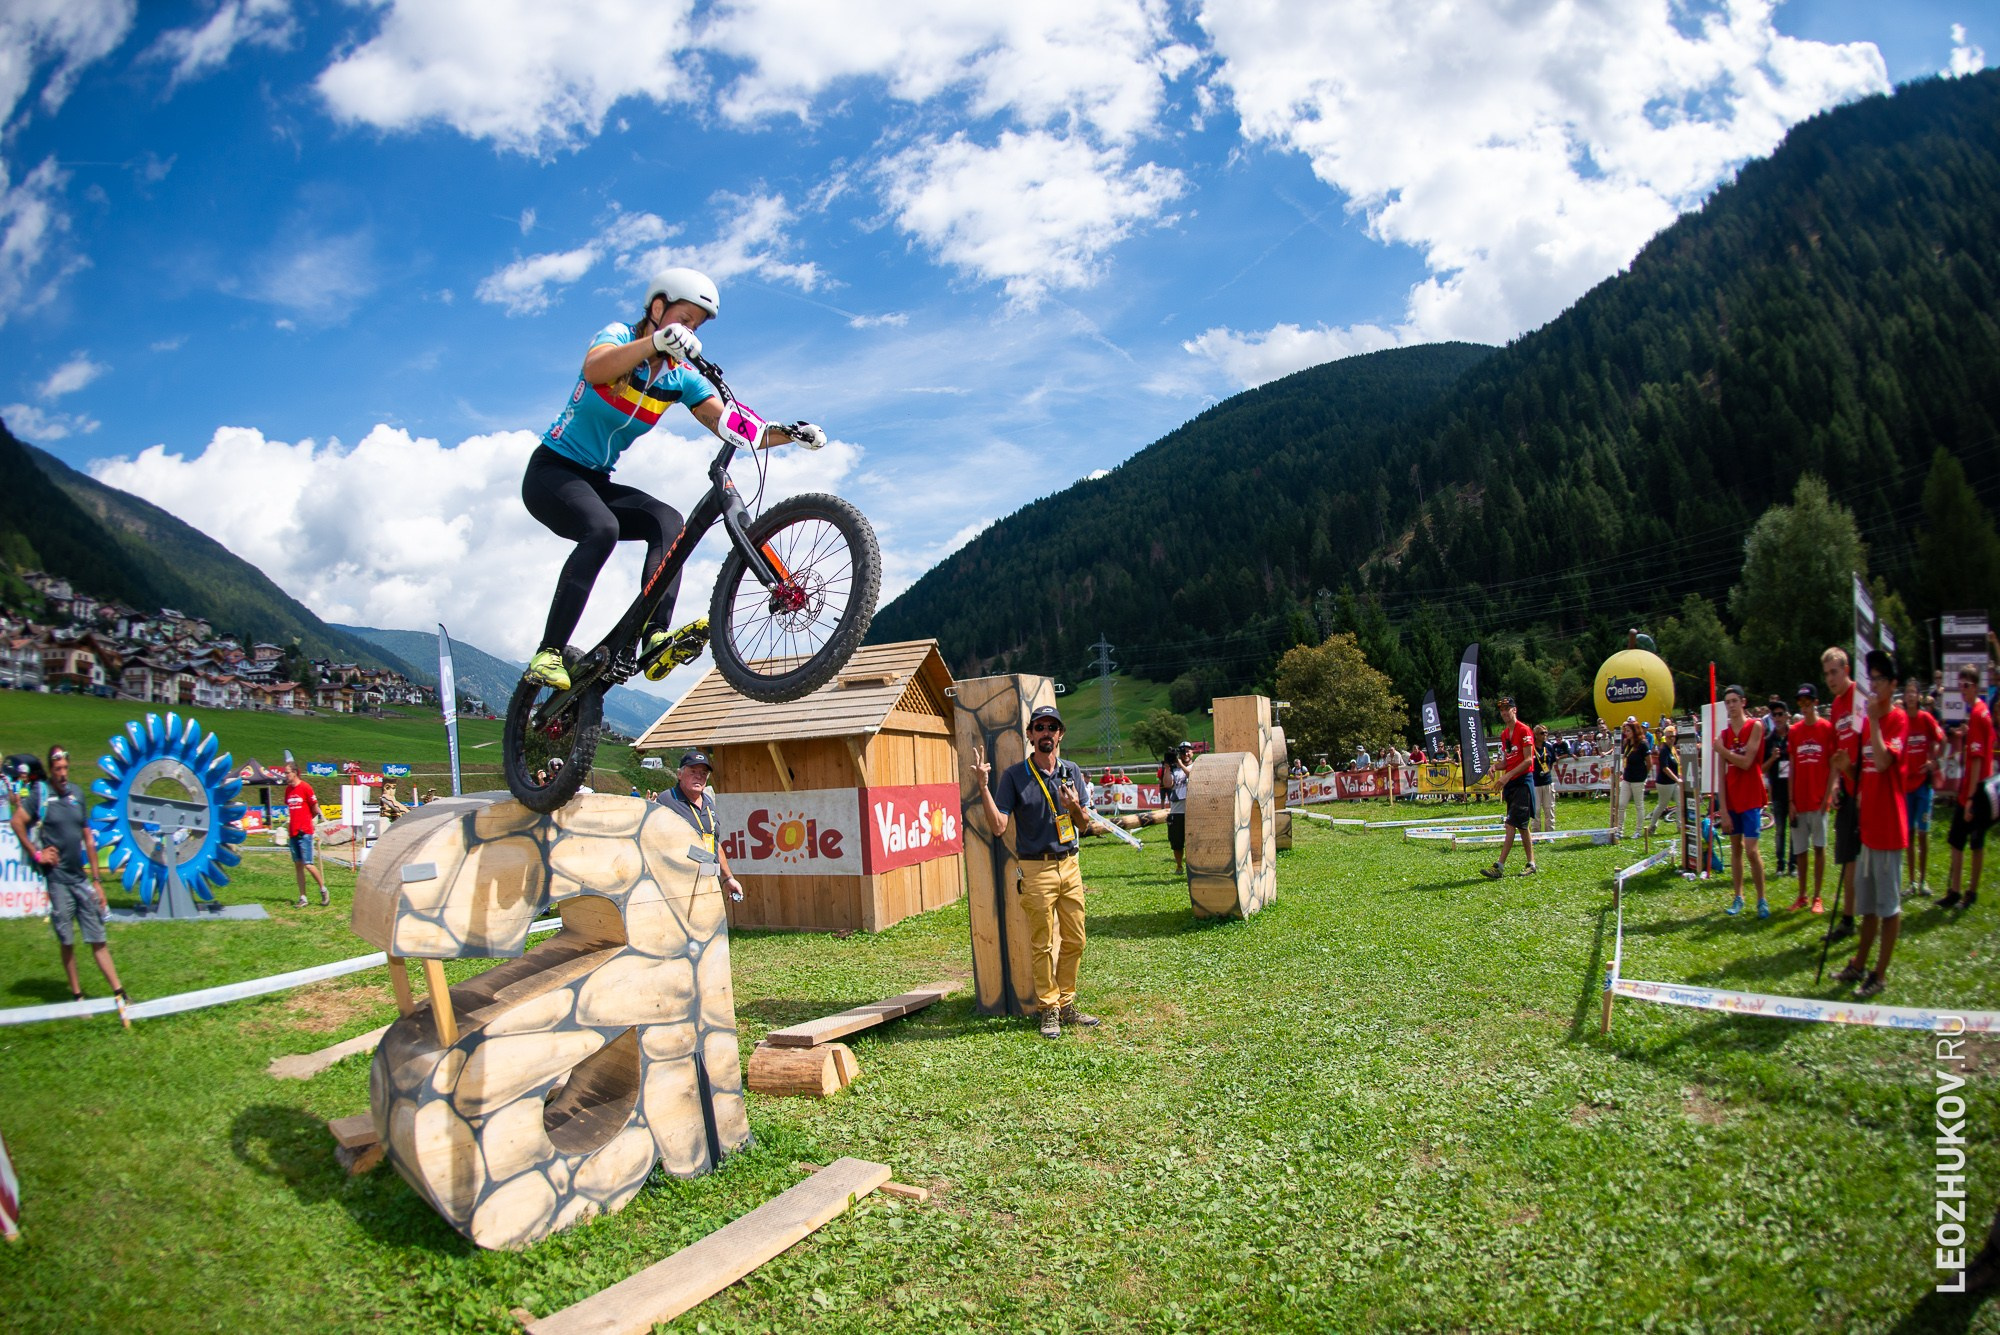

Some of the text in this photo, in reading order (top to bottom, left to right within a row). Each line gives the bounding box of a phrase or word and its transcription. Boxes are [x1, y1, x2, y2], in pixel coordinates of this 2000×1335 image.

[1462, 670, 1473, 696] 4
[1607, 682, 1646, 697] Melinda
[1462, 700, 1475, 708] UCI
[1425, 707, 1435, 724] 3
[1467, 716, 1482, 773] #TrialsWorlds
[1553, 763, 1577, 785] Val
[1578, 771, 1589, 784] di
[1686, 761, 1695, 788] 4
[1289, 782, 1332, 801] di Sole
[1340, 775, 1358, 795] Val
[1360, 782, 1368, 793] di
[1094, 789, 1133, 806] di Sole
[366, 823, 377, 838] 2
[722, 808, 844, 862] di Sole
[874, 799, 957, 858] Val di Sole
